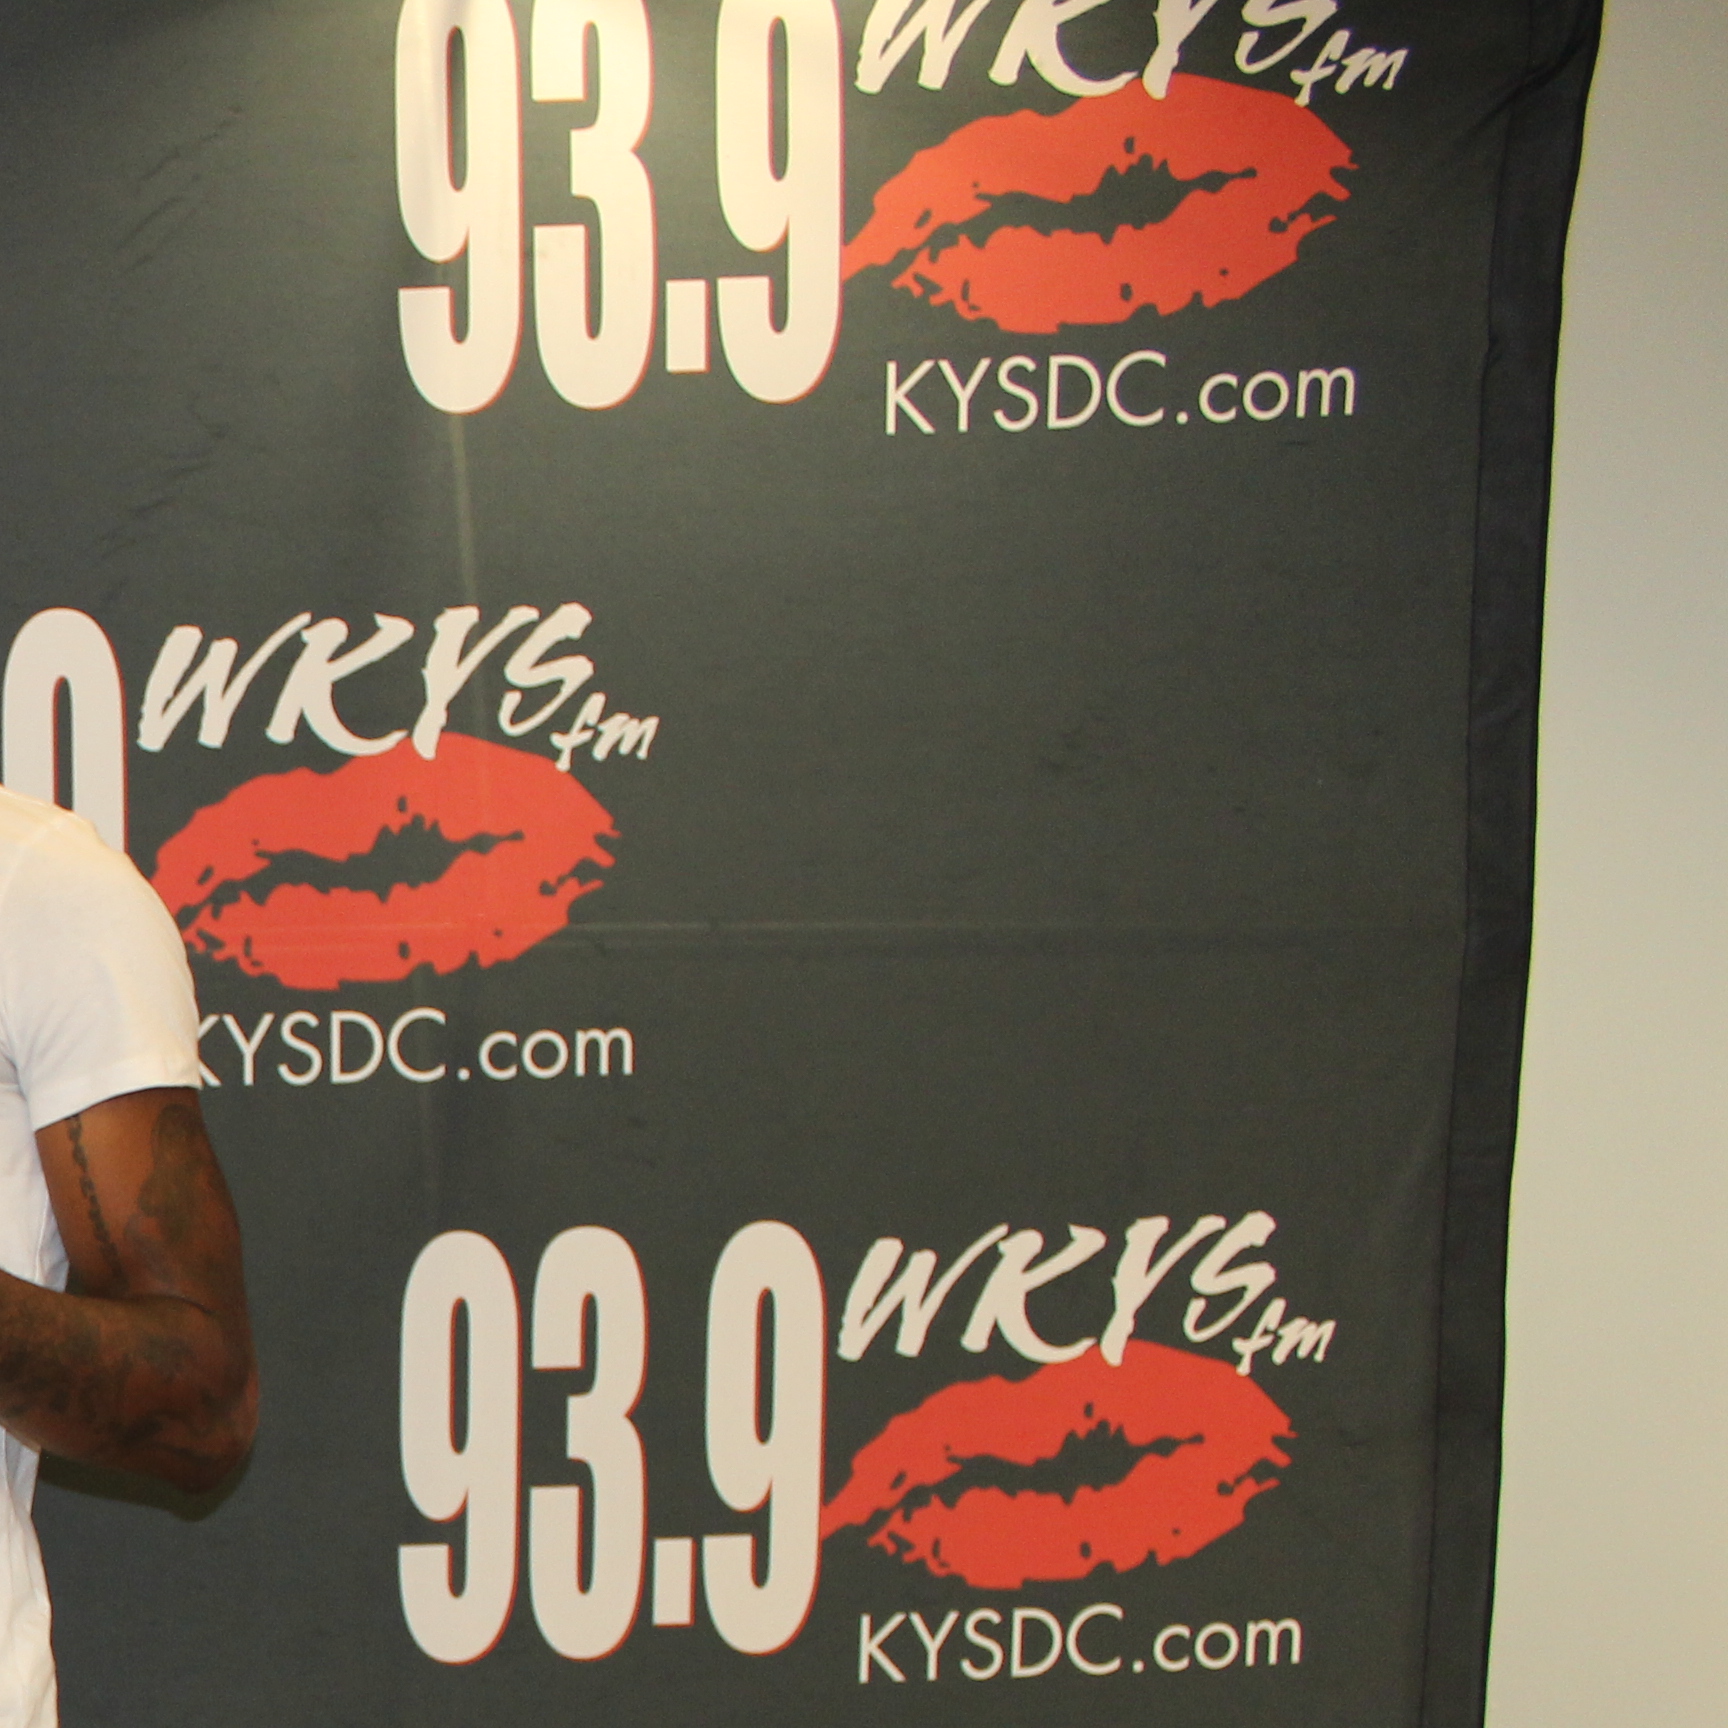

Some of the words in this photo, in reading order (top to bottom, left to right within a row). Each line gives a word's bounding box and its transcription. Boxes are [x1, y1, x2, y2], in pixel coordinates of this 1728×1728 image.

[394, 0, 843, 414] 93.9
[885, 350, 1355, 436] KYSDC.com
[137, 602, 593, 760] WKYS
[397, 1221, 825, 1663] 93.9
[837, 1210, 1275, 1367] WKYS
[858, 1604, 1301, 1684] KYSDC.com
